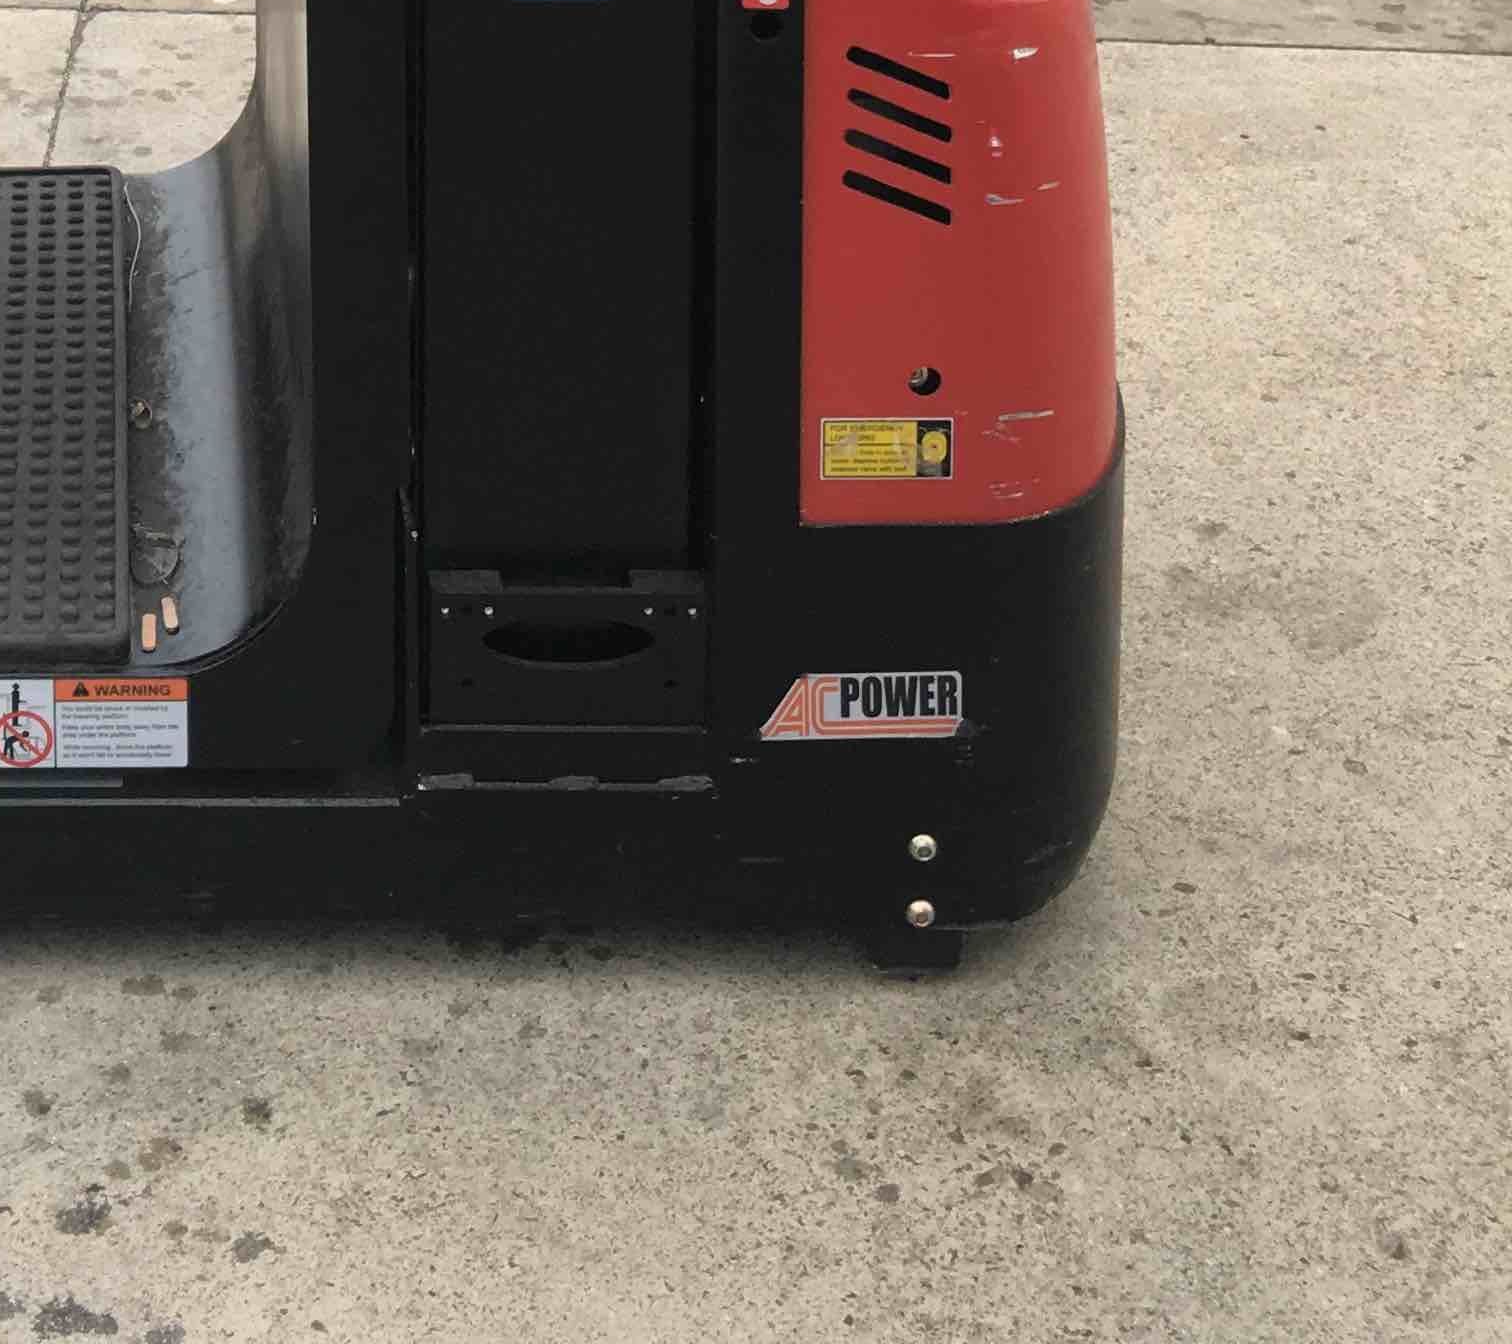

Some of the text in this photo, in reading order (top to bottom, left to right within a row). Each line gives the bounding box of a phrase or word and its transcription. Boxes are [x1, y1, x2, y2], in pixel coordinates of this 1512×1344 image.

[94, 684, 170, 697] WARNING
[760, 674, 958, 737] AC POWER
